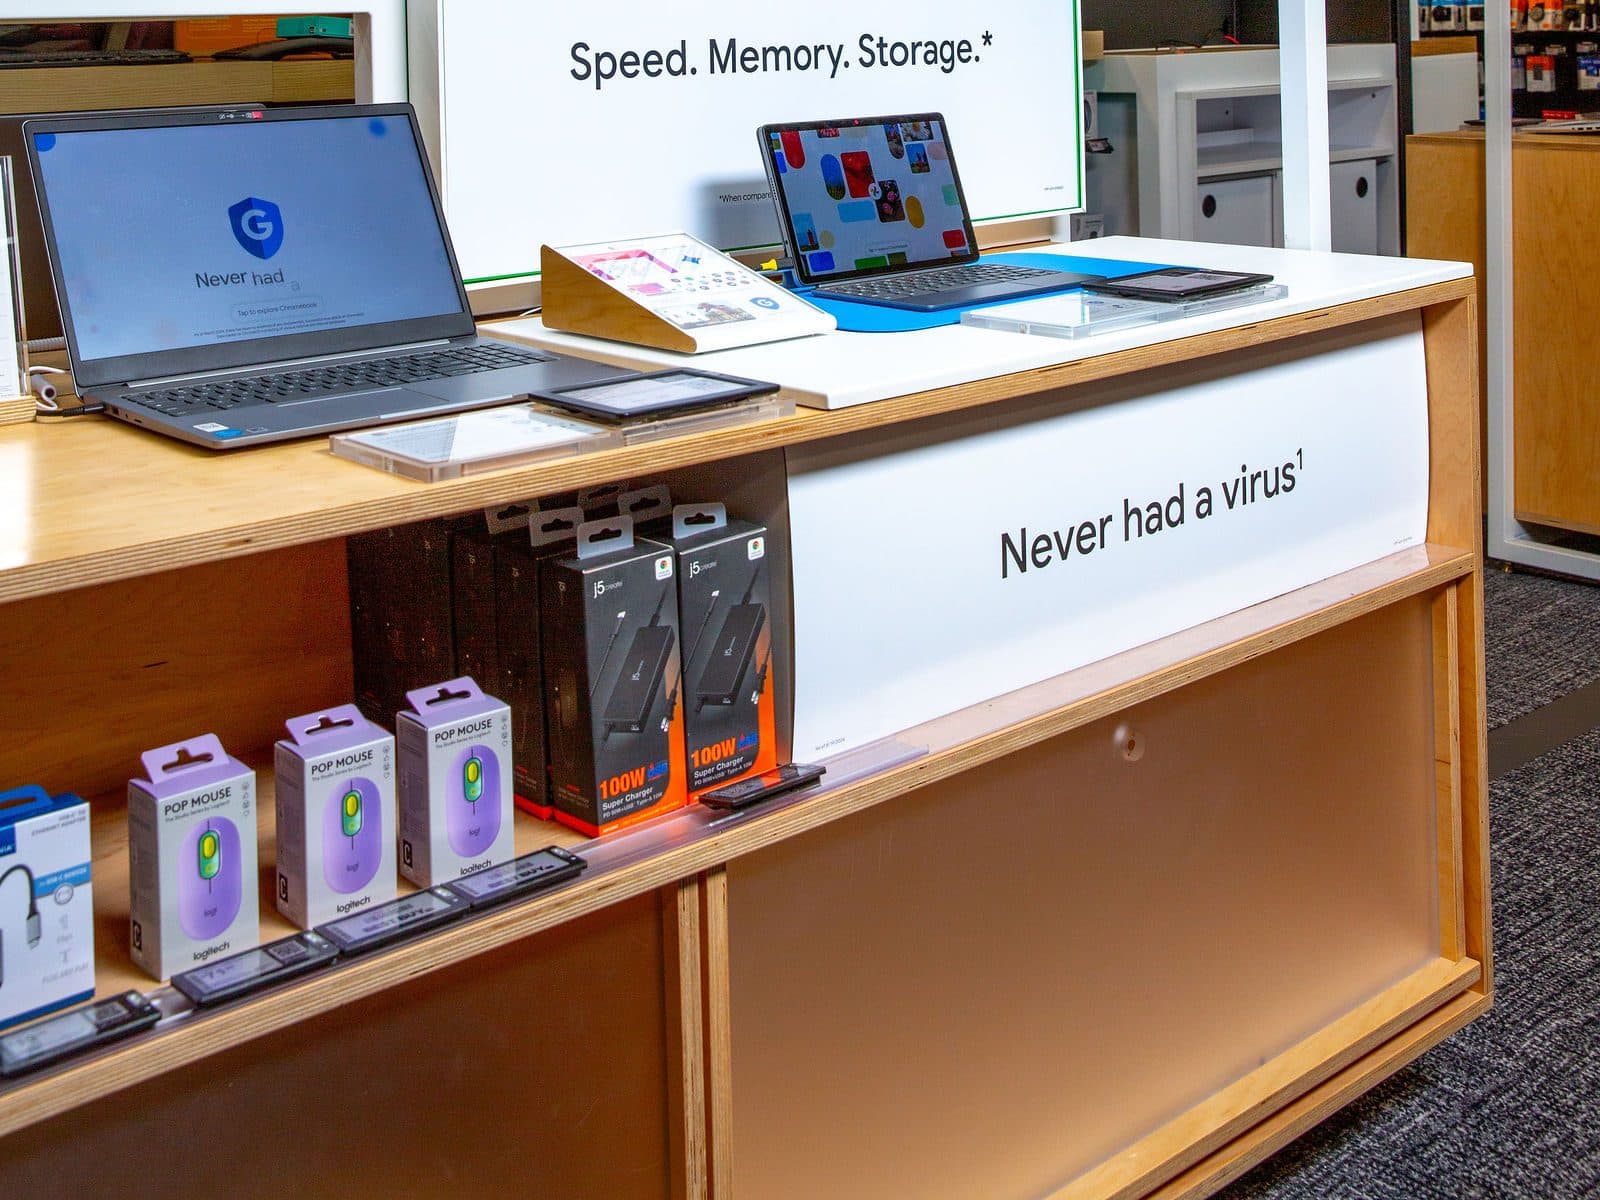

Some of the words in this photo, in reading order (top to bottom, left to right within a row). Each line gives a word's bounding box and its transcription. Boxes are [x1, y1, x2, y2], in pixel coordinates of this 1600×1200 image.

[570, 39, 698, 90] Speed.
[709, 37, 851, 79] Memory.
[195, 271, 248, 289] Never
[252, 267, 285, 286] had
[1000, 512, 1114, 579] Never
[1123, 481, 1186, 542] had
[1195, 486, 1213, 520] a
[434, 728, 456, 743] POP
[457, 718, 493, 737] MOUSE
[311, 760, 334, 775] POP
[336, 749, 374, 769] MOUSE
[691, 736, 736, 769] 100W
[694, 767, 715, 780] Super
[716, 756, 745, 772] Charger
[599, 765, 646, 800] 100W
[164, 799, 189, 816] POP
[191, 786, 232, 808] MOUSE
[602, 798, 624, 811] Super
[625, 786, 653, 802] Charger
[336, 895, 371, 913] logitech
[193, 941, 230, 961] logitech
